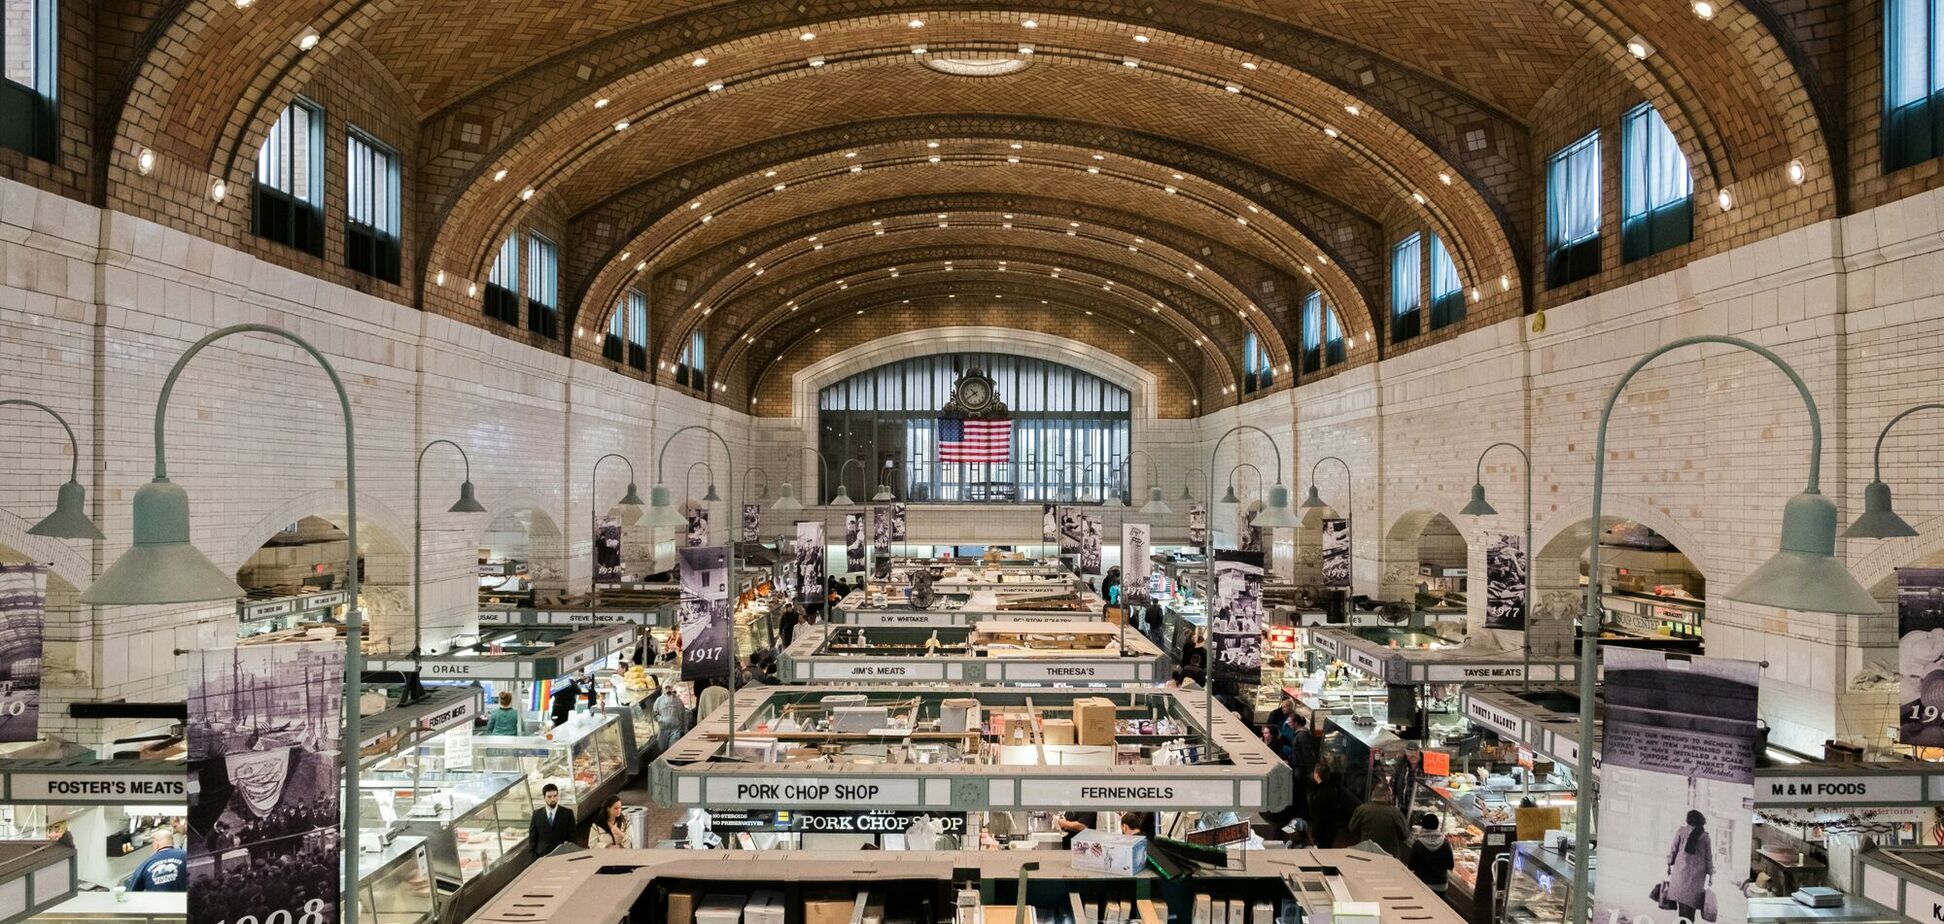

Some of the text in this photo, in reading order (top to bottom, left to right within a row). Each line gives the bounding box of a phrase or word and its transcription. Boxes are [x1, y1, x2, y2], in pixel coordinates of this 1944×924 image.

[801, 586, 821, 594] 1927
[1127, 587, 1147, 595] 1976
[1491, 607, 1520, 618] 1977
[688, 645, 723, 664] 1917
[432, 665, 469, 674] ORALE
[851, 667, 906, 676] JIM'S MEATS
[1046, 667, 1095, 676] THERESA'S
[1463, 668, 1521, 677] TAYSE MEATS
[429, 704, 466, 727] FOSTER'S MEATS
[1703, 739, 1733, 748] RECHECK
[1640, 752, 1669, 761] PURPOSE
[1696, 760, 1725, 769] MARKET
[1673, 750, 1710, 760] INSTALLED
[48, 780, 184, 795] FOSTER'S MEATS
[737, 784, 879, 800] PORK CHOP SHOP
[1081, 786, 1174, 799] FERNENGELS
[1771, 783, 1866, 795] M & M FOODS
[801, 814, 964, 831] PORK CHOP SOP
